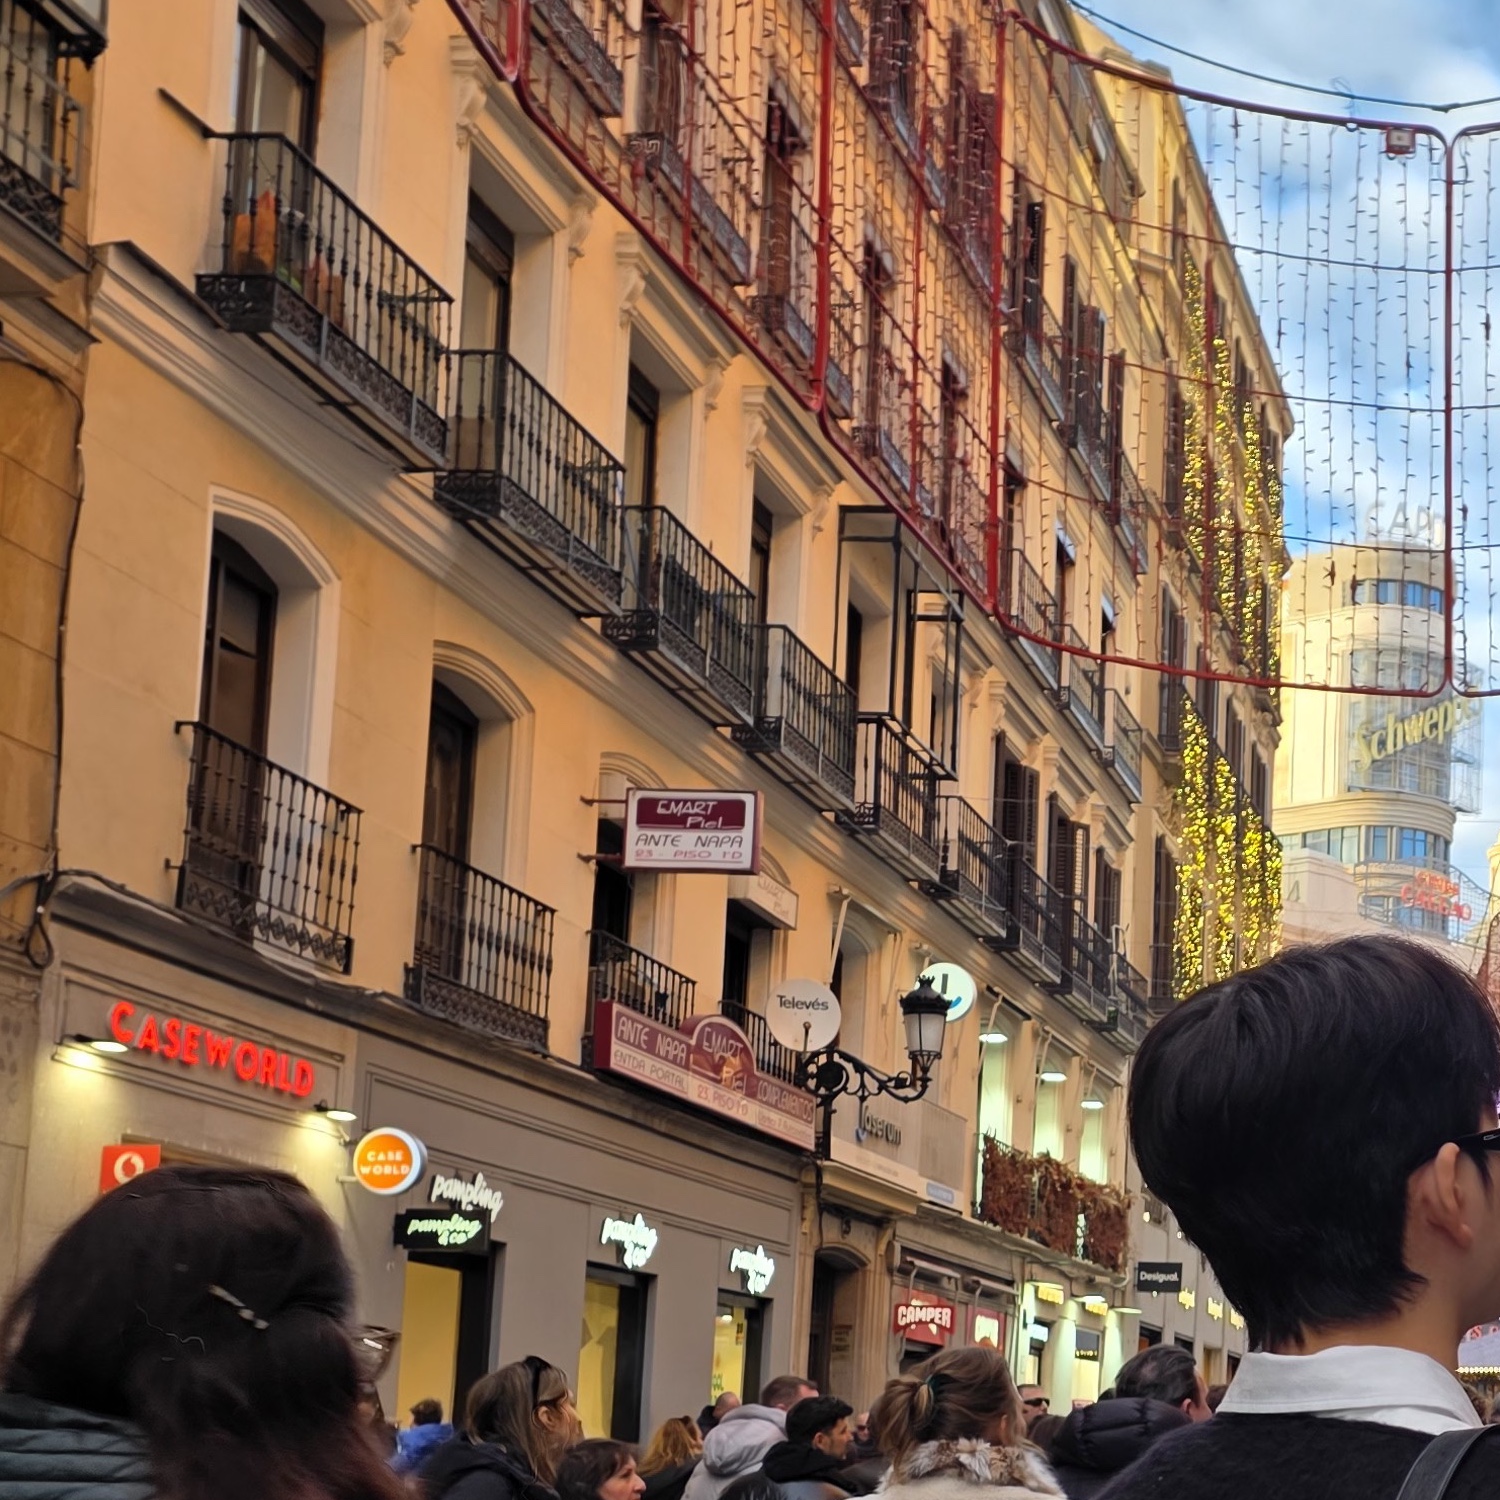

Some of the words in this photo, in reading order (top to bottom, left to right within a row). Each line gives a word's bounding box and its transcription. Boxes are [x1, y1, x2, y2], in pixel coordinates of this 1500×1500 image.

[1355, 691, 1483, 772] Schwepp
[656, 800, 718, 817] EMART
[686, 816, 723, 829] Piel
[635, 833, 683, 847] ANTE
[694, 835, 744, 848] NAPA
[673, 850, 712, 859] PISO
[777, 994, 829, 1011] Televés
[109, 1000, 315, 1098] CASEWORLD
[616, 1014, 650, 1050] ANTE
[655, 1033, 688, 1067] NAPA
[702, 1026, 745, 1061] EMART
[366, 1151, 404, 1162] CASE
[360, 1164, 410, 1176] WORLD
[897, 1304, 952, 1329] CAMPER
